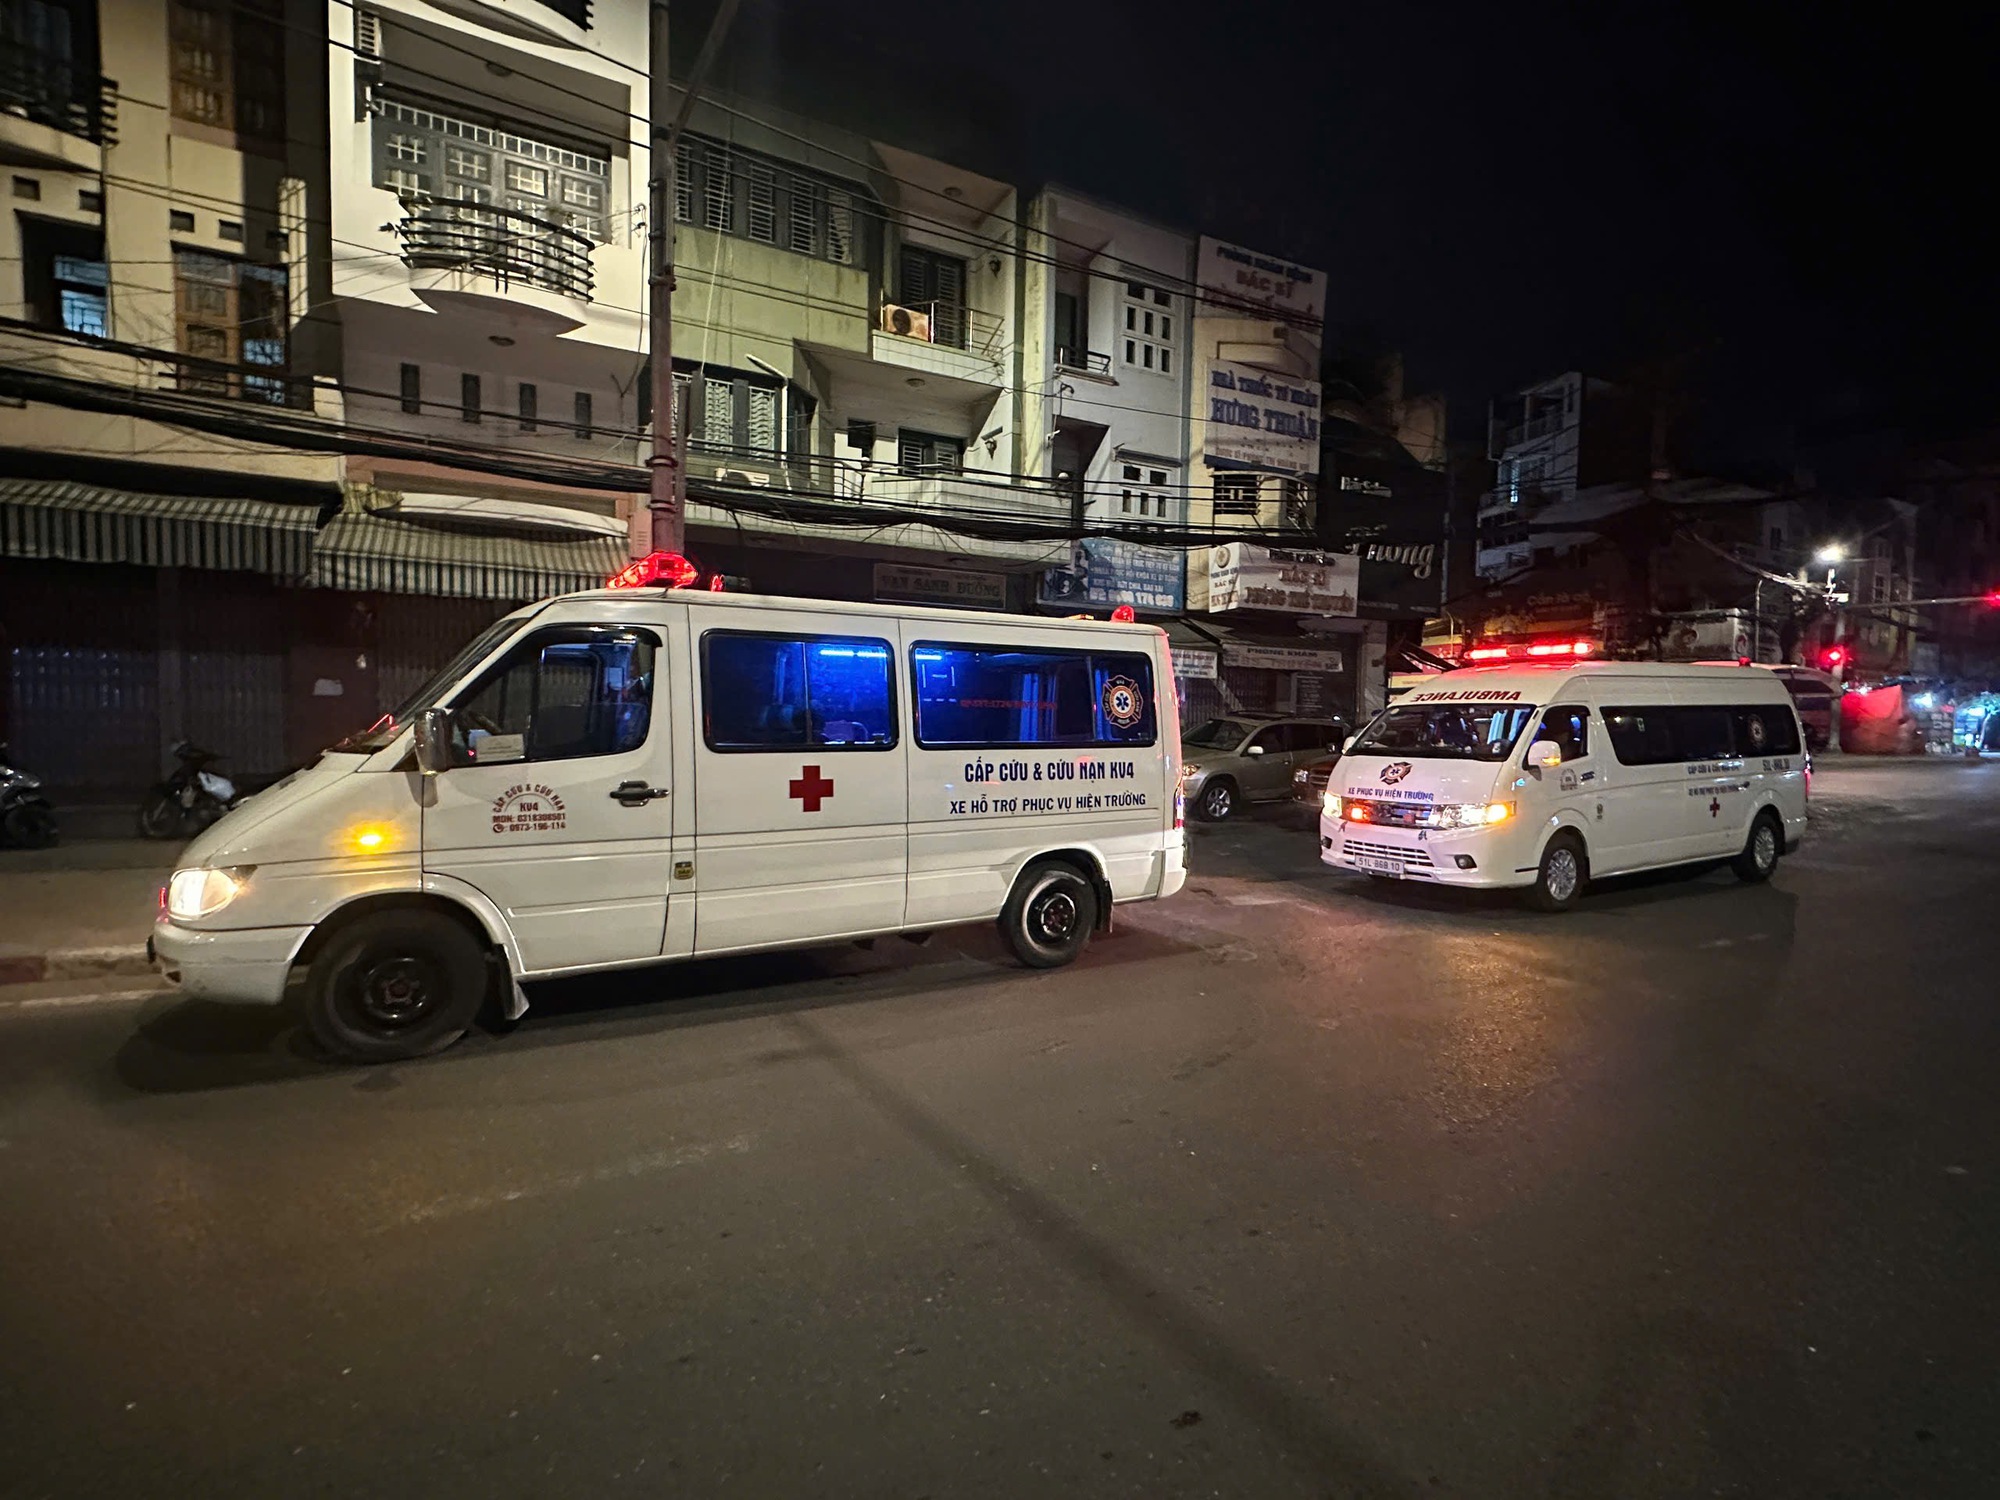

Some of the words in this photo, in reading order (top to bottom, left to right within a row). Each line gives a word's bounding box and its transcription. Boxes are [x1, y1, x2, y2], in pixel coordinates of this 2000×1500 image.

[964, 757, 993, 782] CẤP
[999, 759, 1028, 782] CỨU
[1033, 764, 1042, 781] &
[1048, 759, 1074, 781] CỨU
[1079, 763, 1105, 784] NẠN
[1110, 762, 1134, 780] KV4
[1357, 788, 1373, 797] PHỤC
[1385, 788, 1402, 798] HIỆN
[520, 803, 539, 812] KV4
[950, 801, 966, 814] XE
[971, 794, 989, 813] HỖ
[993, 798, 1018, 815] TRỢ
[1023, 797, 1054, 813] PHỤC
[1057, 797, 1073, 811] VỤ
[1076, 793, 1101, 810] HIỆN
[1105, 791, 1146, 807] TRƯỜNG
